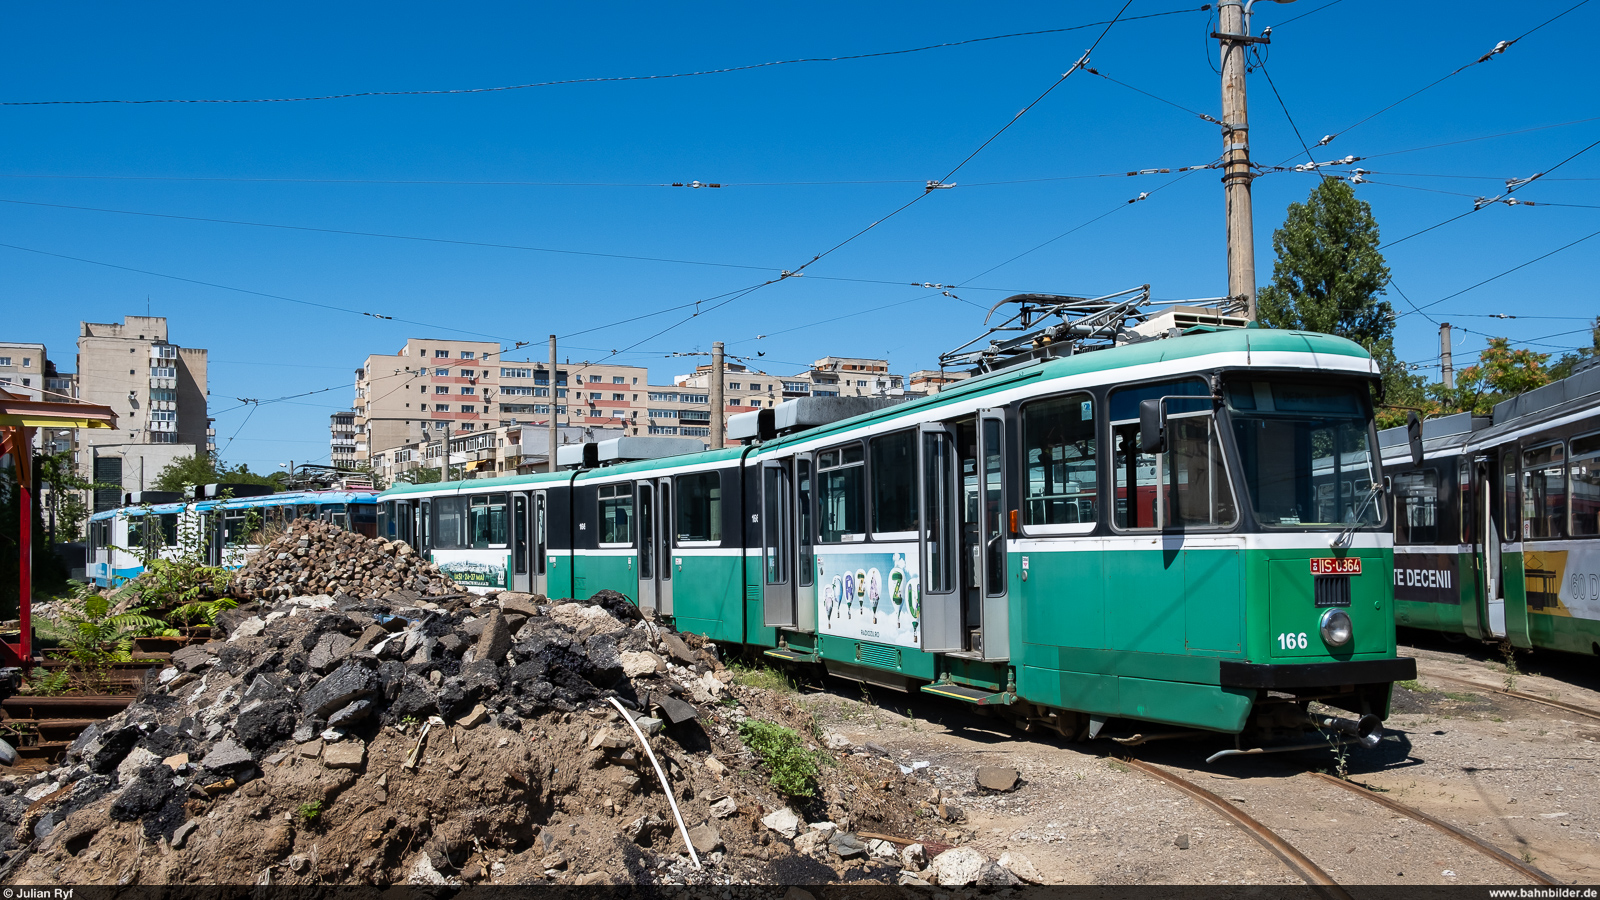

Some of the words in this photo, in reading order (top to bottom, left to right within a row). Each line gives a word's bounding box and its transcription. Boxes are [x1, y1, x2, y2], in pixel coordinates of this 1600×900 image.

[1406, 569, 1452, 589] DECENII
[1570, 573, 1586, 600] 60
[1589, 573, 1600, 601] D
[1277, 632, 1308, 650] 166
